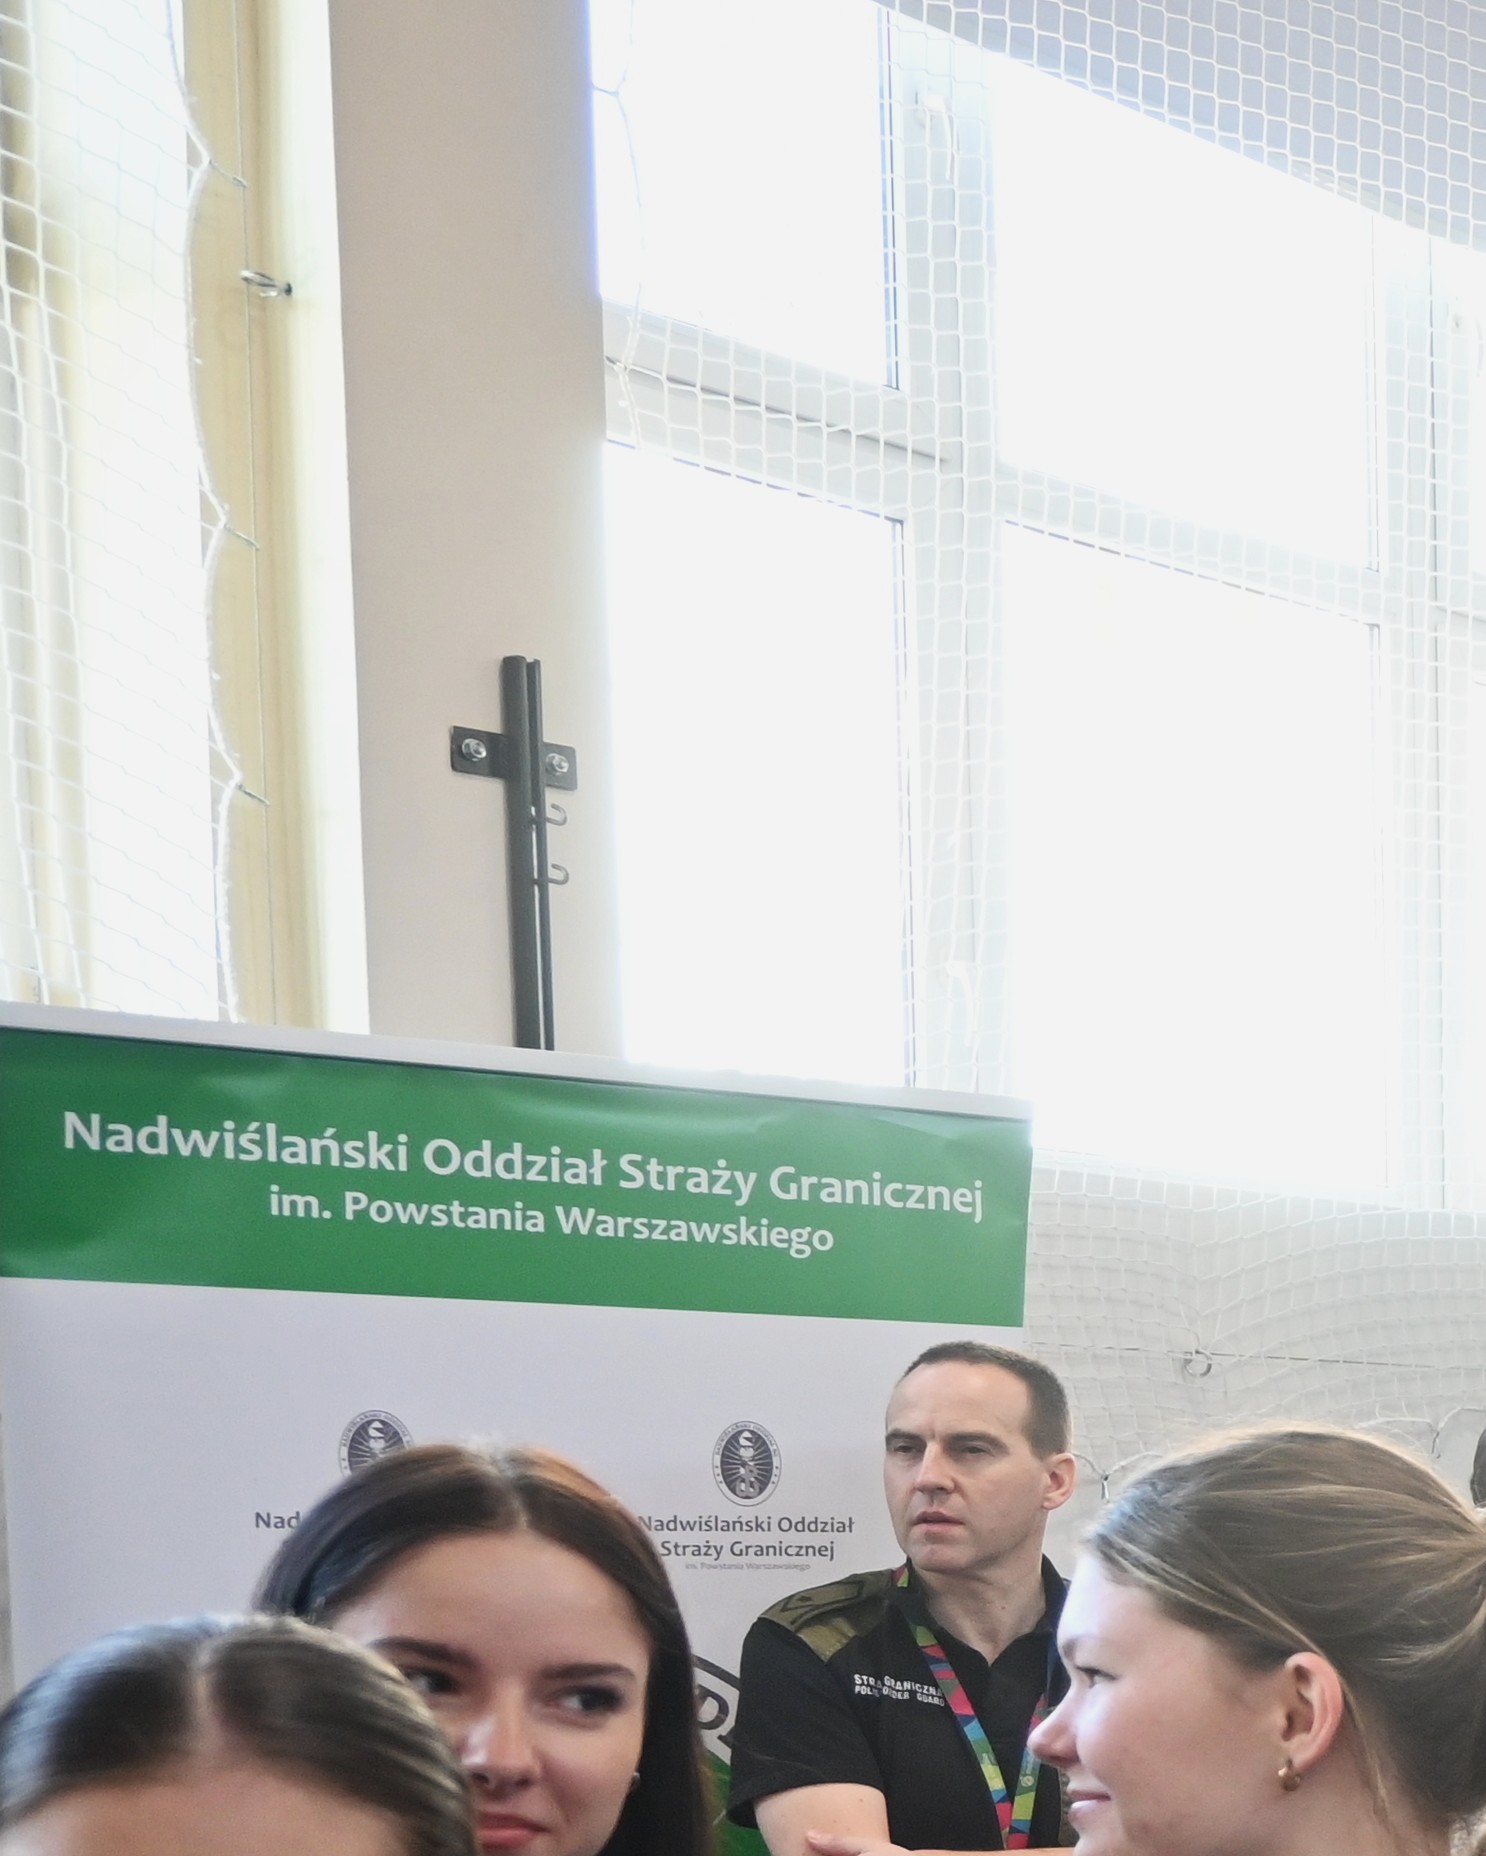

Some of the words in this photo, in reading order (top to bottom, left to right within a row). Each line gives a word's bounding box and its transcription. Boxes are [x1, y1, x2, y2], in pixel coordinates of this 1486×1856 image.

[63, 1110, 409, 1172] Nadwiślański
[422, 1138, 608, 1186] Oddział
[618, 1153, 757, 1206] Straży
[769, 1166, 984, 1224] Granicznej
[269, 1185, 332, 1219] im.
[344, 1190, 546, 1233] Powstania
[555, 1205, 835, 1259] Warszawskiego
[777, 1516, 855, 1534] Oddział
[660, 1540, 724, 1562] Straży
[729, 1540, 835, 1562] Granicznej
